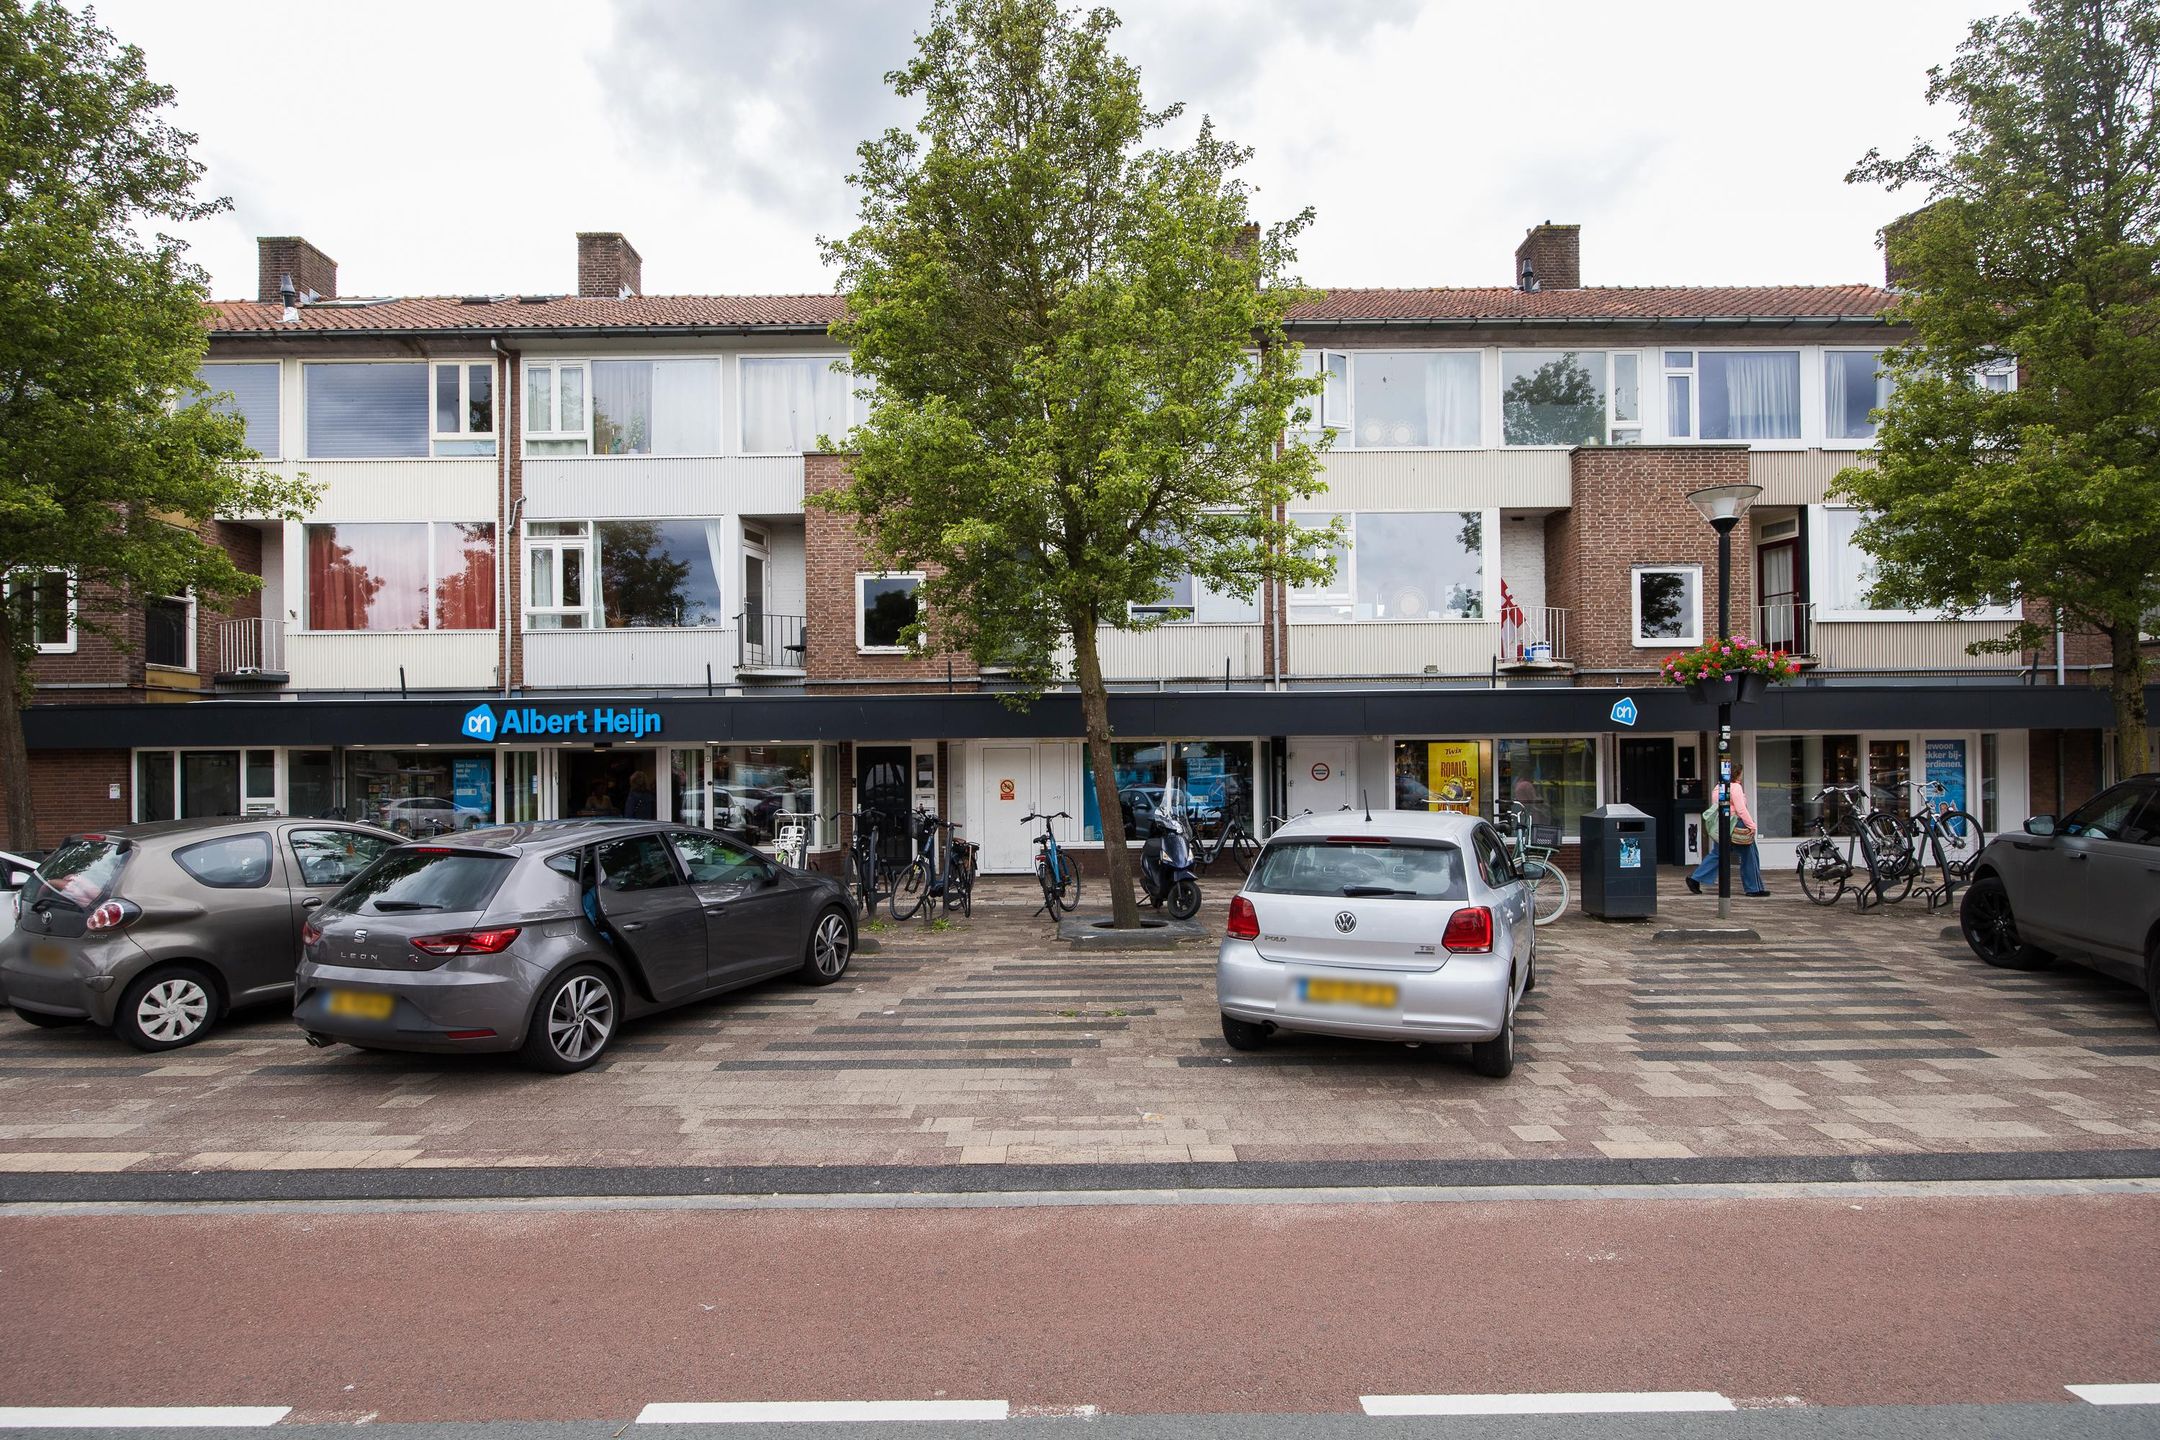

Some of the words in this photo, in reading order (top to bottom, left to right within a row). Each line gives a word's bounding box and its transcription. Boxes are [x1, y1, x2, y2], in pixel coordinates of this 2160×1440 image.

[500, 708, 588, 734] Albert
[593, 708, 662, 738] Heijn
[1445, 747, 1462, 755] Twix
[1926, 760, 1963, 768] erdienen.
[1440, 760, 1468, 777] ROMIG
[1264, 935, 1287, 943] POLO
[340, 951, 378, 960] LEON
